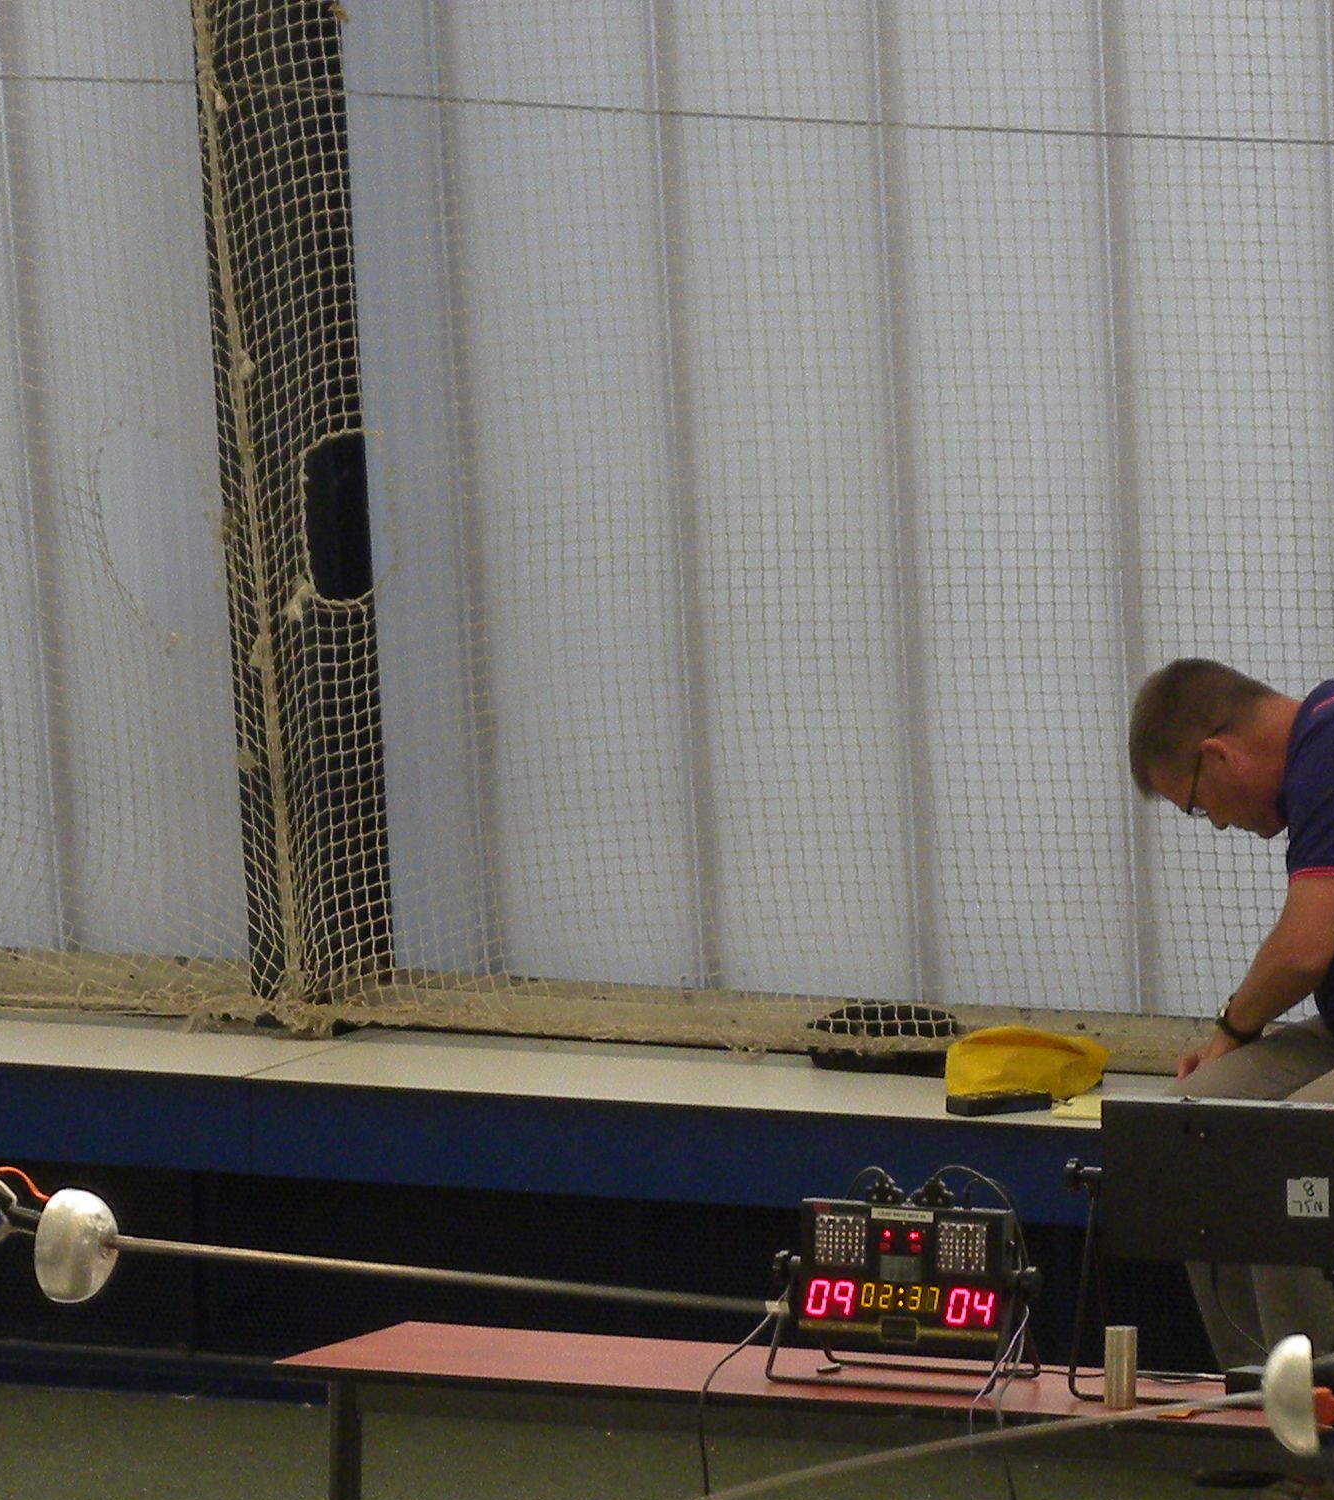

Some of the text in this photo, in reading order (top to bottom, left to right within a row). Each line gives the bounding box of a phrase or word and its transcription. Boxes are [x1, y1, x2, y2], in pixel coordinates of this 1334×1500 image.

[1302, 1179, 1315, 1197] 8
[805, 1279, 995, 1327] 09 02:37 04
